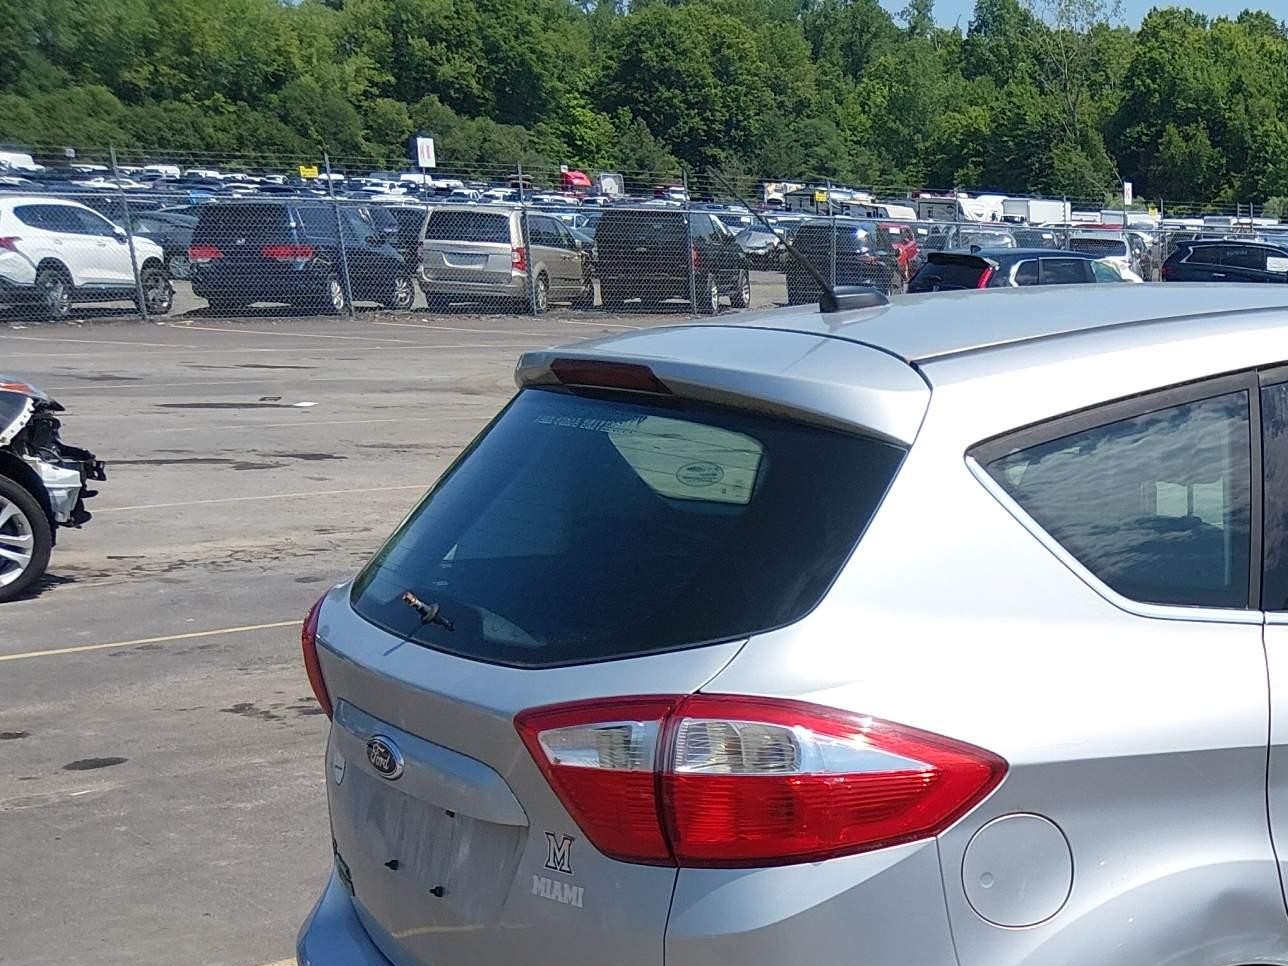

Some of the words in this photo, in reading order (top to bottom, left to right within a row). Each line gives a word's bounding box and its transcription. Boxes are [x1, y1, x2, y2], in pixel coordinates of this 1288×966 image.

[370, 743, 391, 770] Ford
[544, 831, 575, 875] M
[532, 874, 584, 908] MIAMI
